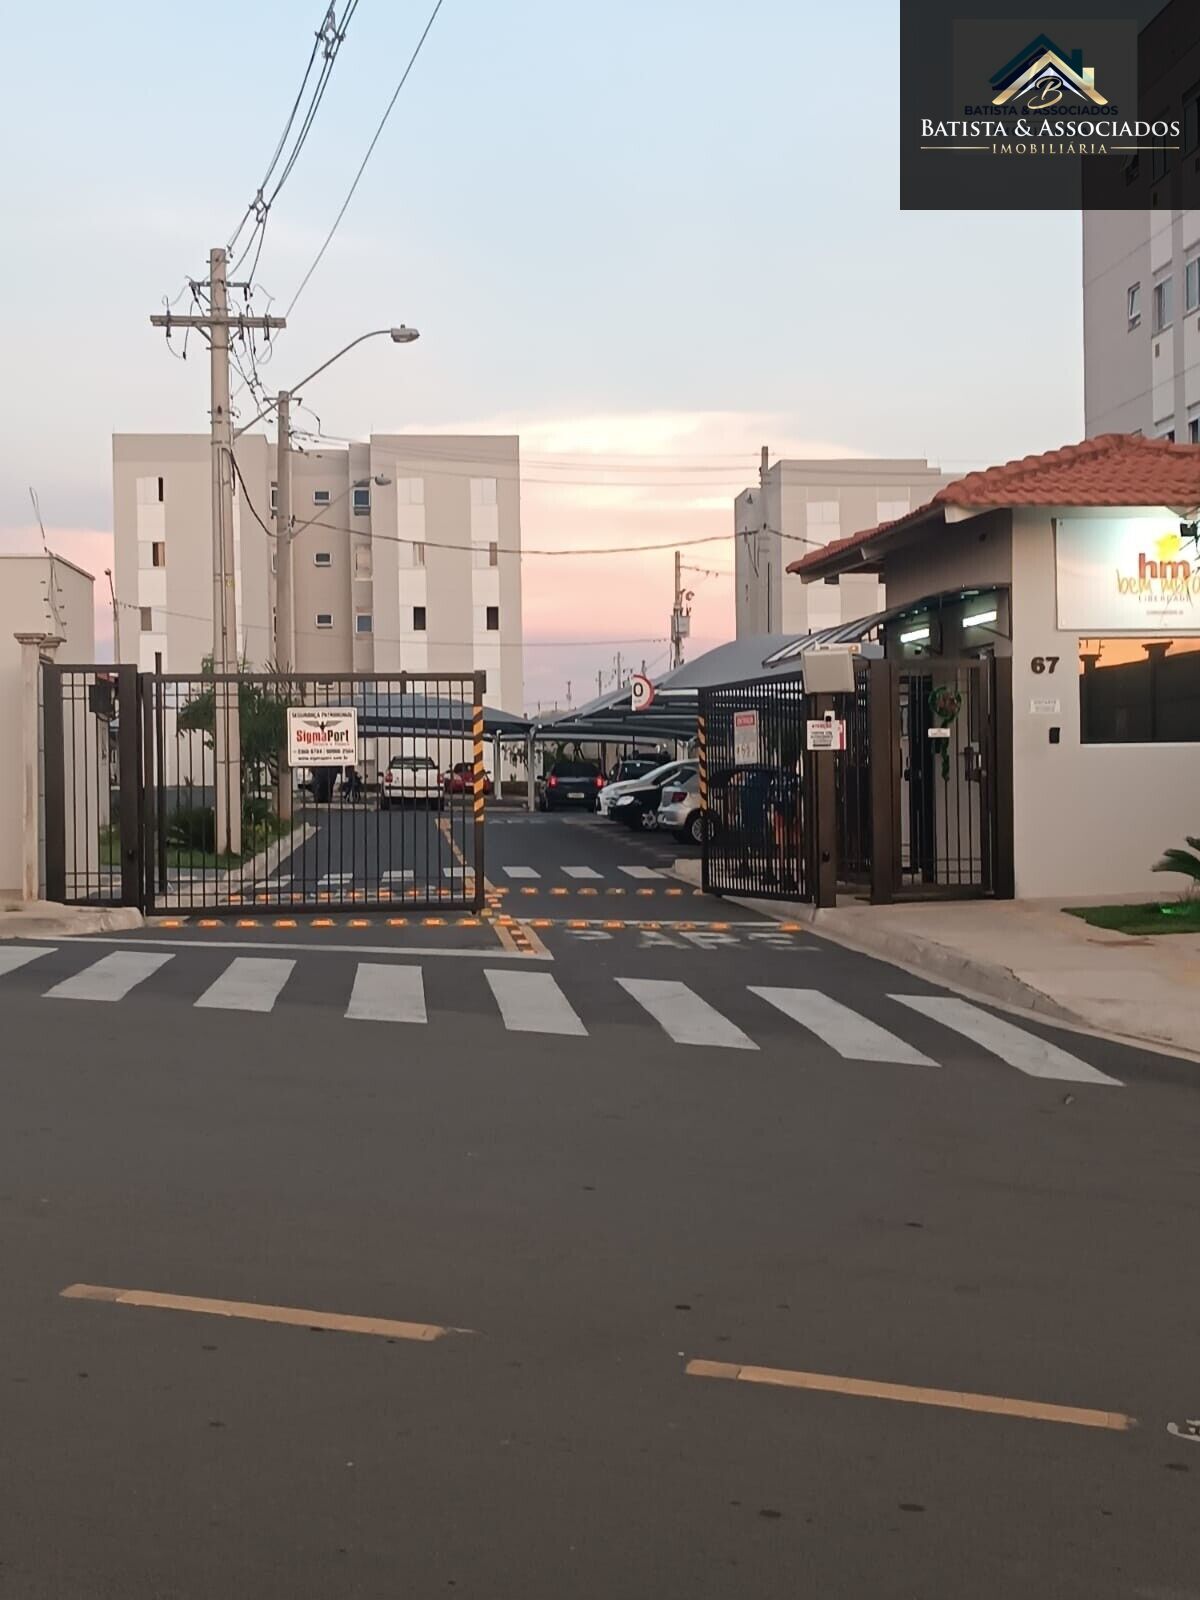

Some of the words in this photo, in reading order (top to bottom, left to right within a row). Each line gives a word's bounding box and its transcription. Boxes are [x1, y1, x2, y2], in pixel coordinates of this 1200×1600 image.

[1138, 552, 1191, 579] hm
[1030, 656, 1060, 674] 67
[296, 729, 349, 744] SigmaPort
